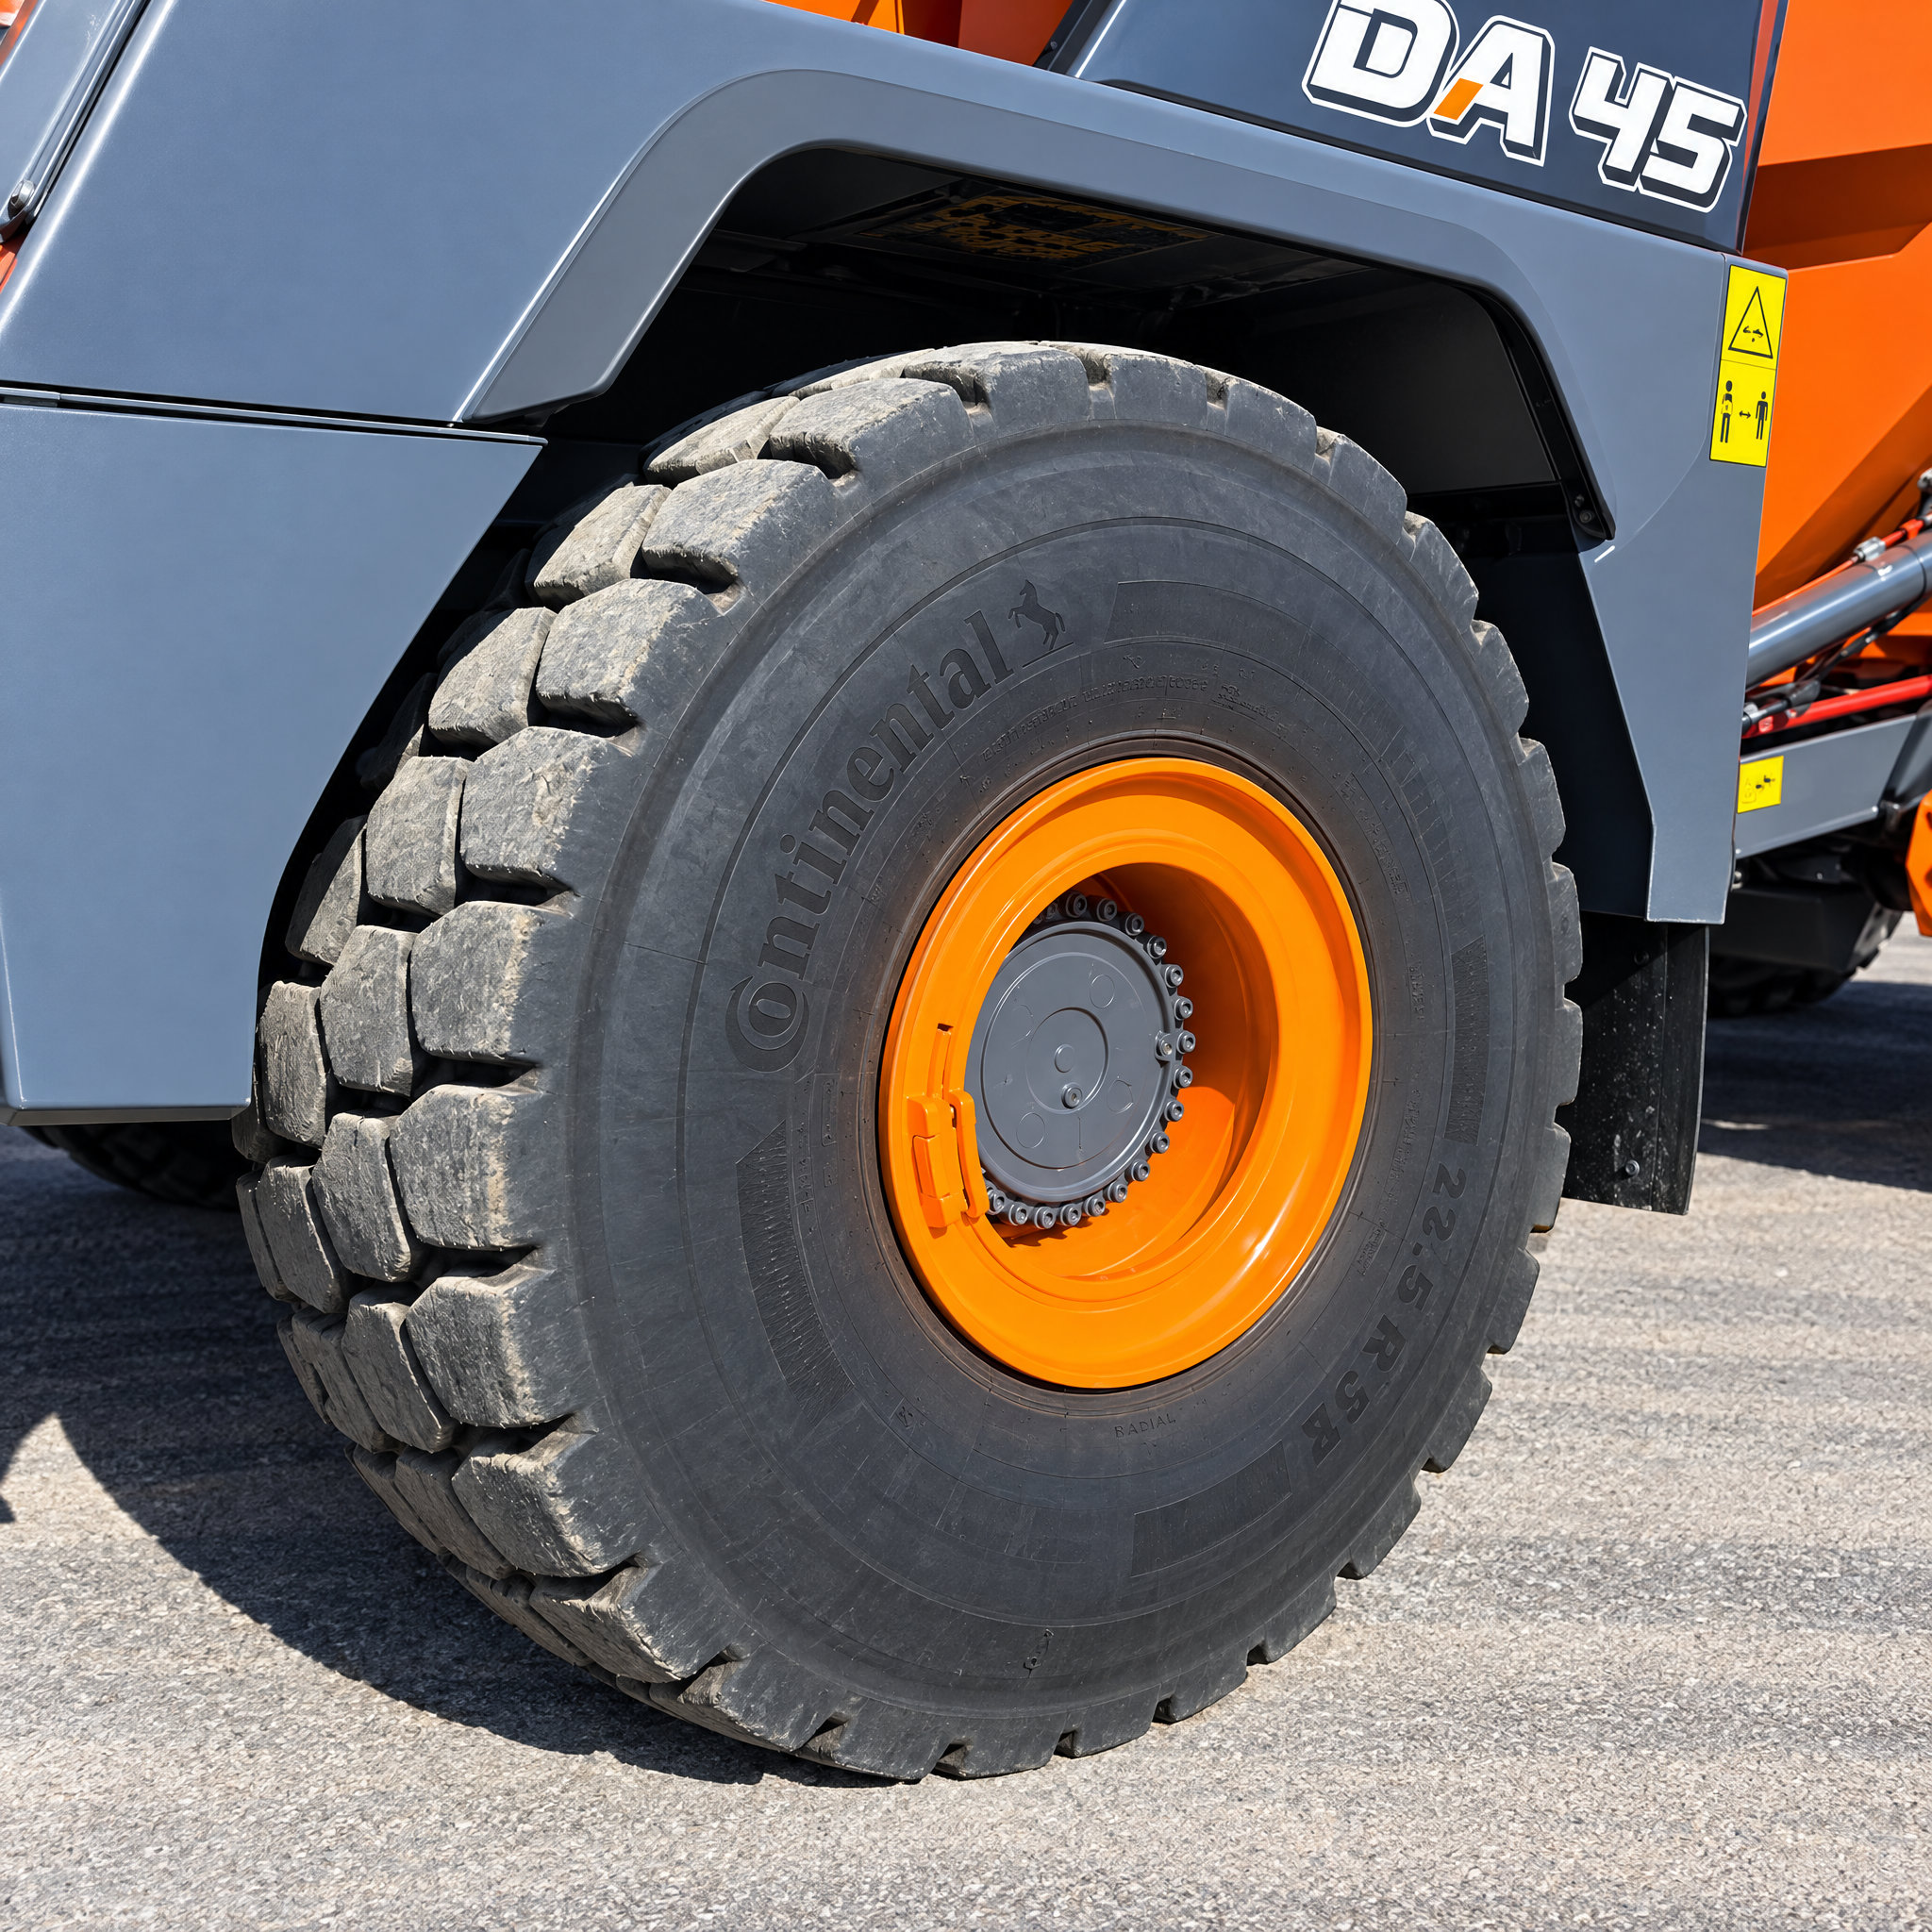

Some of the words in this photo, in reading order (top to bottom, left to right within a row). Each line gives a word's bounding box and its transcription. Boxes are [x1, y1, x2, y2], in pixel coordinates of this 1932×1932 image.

[1302, 0, 1555, 167] DA
[1569, 46, 1747, 213] 45
[725, 609, 1015, 1073] Continental
